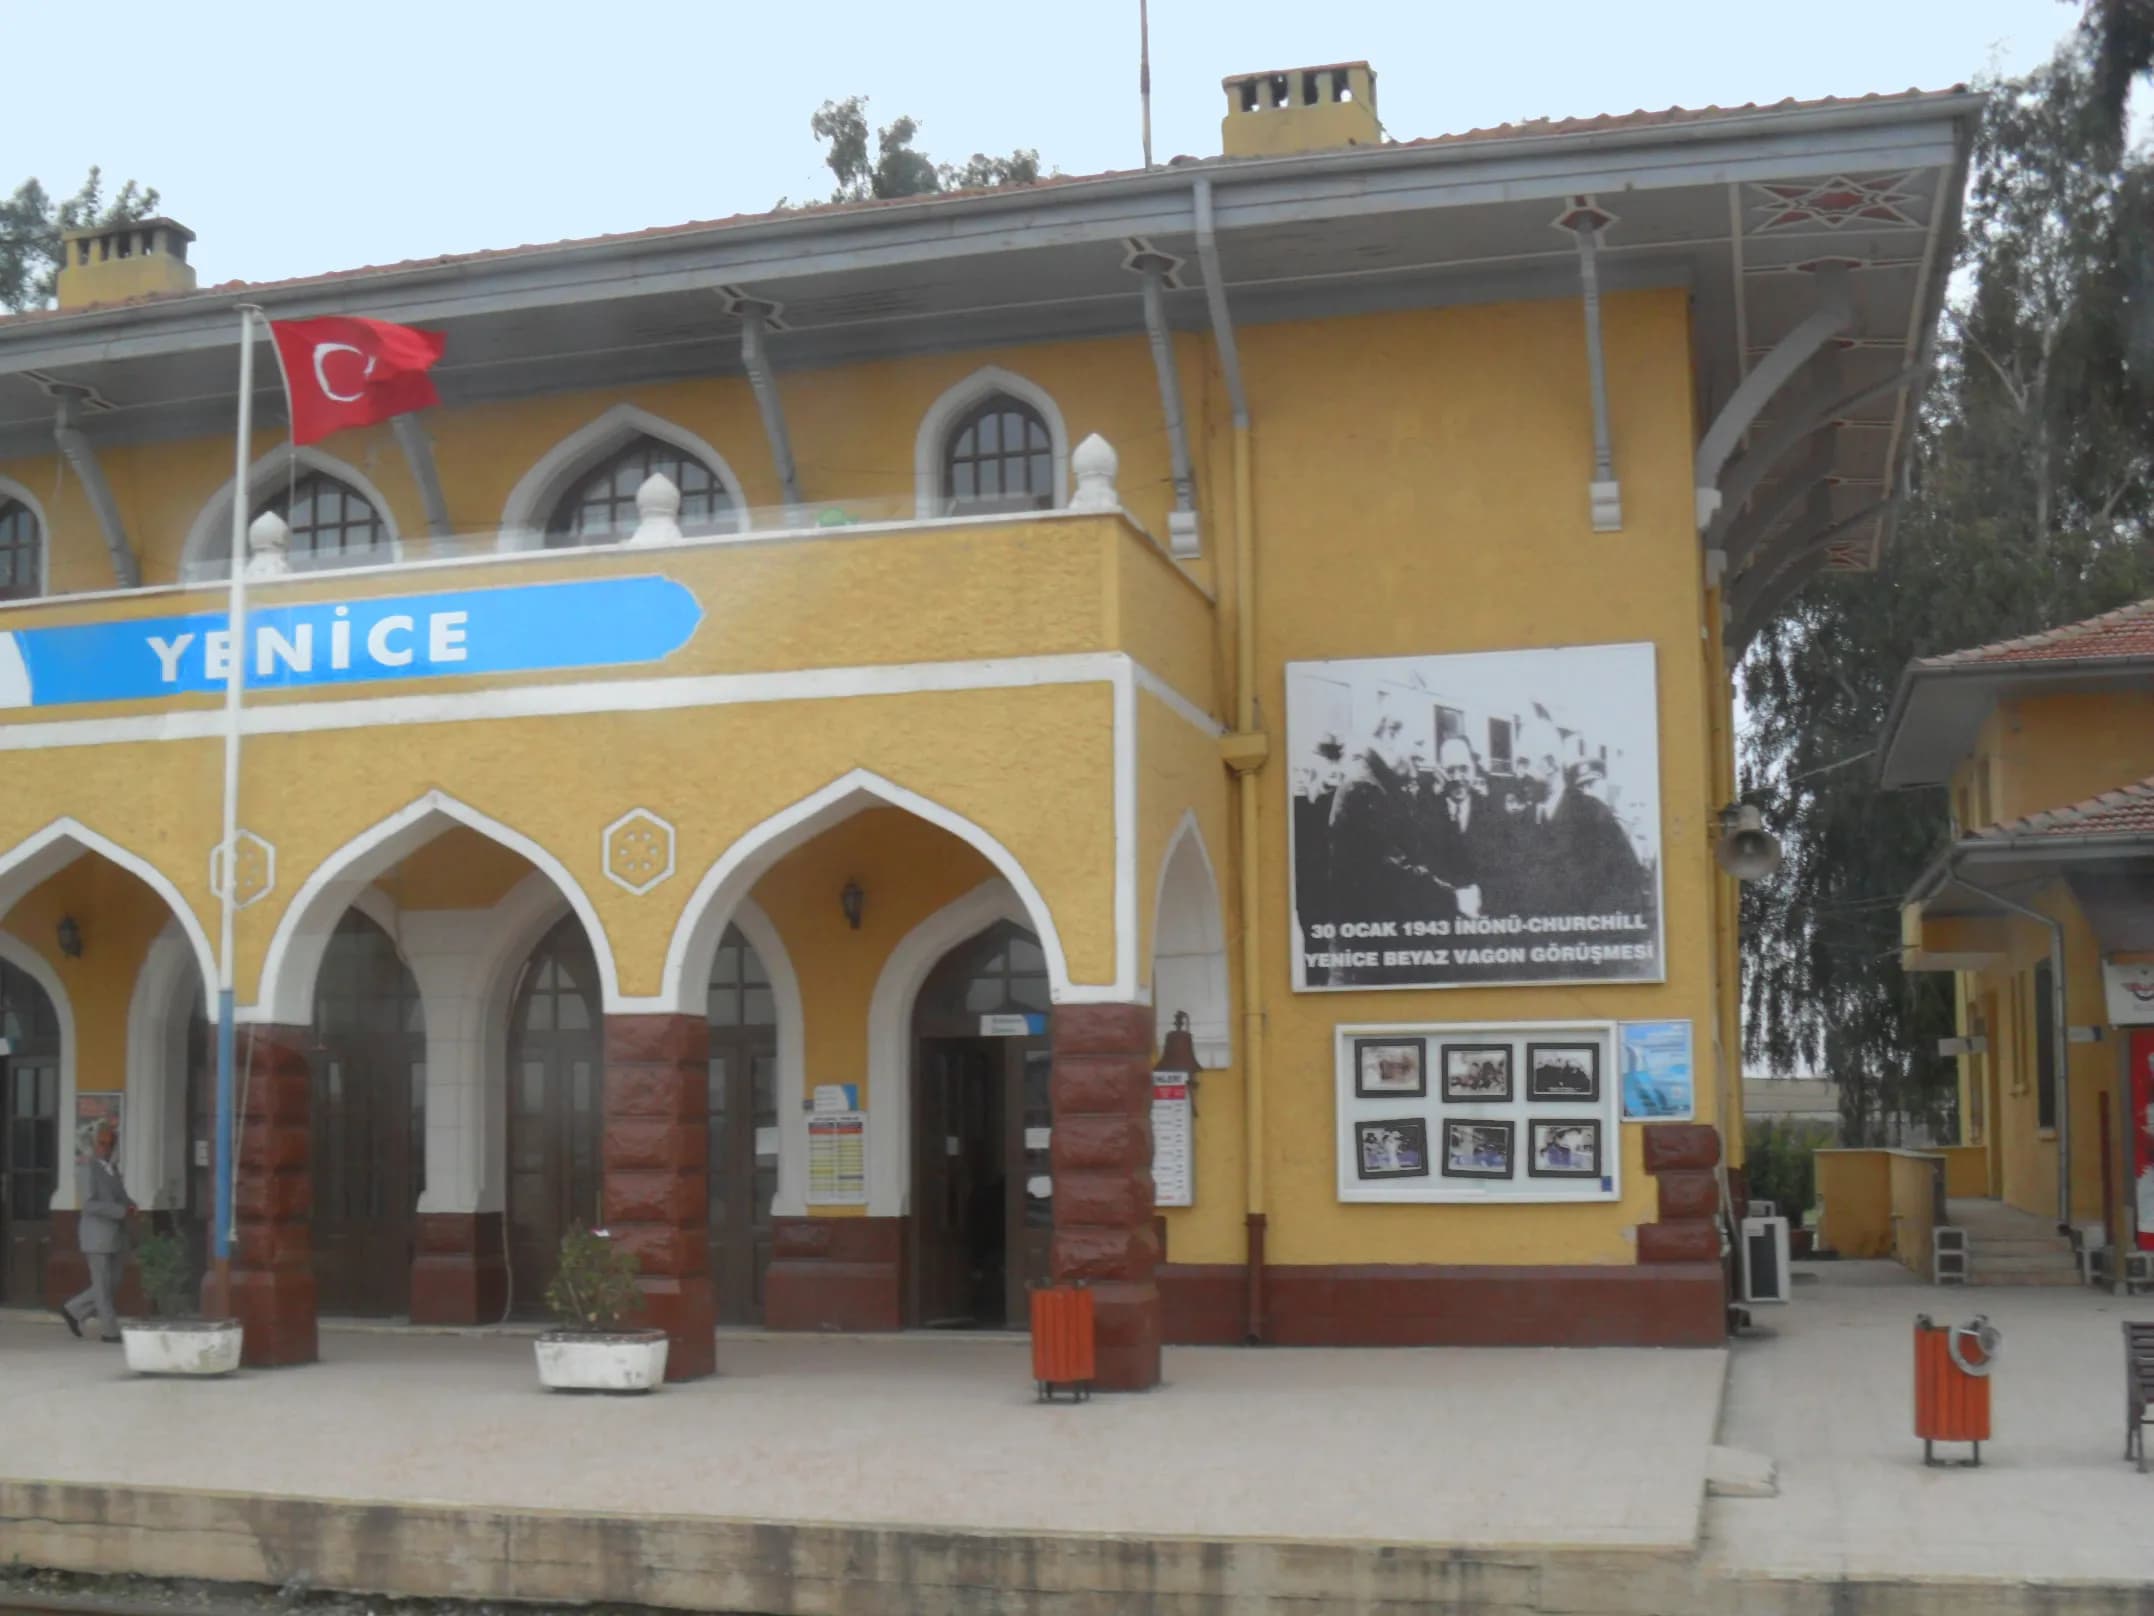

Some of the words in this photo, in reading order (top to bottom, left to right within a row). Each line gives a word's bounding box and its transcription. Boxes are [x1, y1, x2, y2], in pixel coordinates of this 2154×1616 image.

[146, 606, 467, 682] YENİCE
[1311, 923, 1336, 939] 30
[1340, 921, 1398, 938] OCAK
[1402, 920, 1450, 936] 1943
[1305, 949, 1379, 967] YENİCE
[1383, 949, 1449, 966] BEYAZ
[1453, 948, 1526, 964] VAGON
[1530, 941, 1655, 964] GÖRÜŞMESİ
